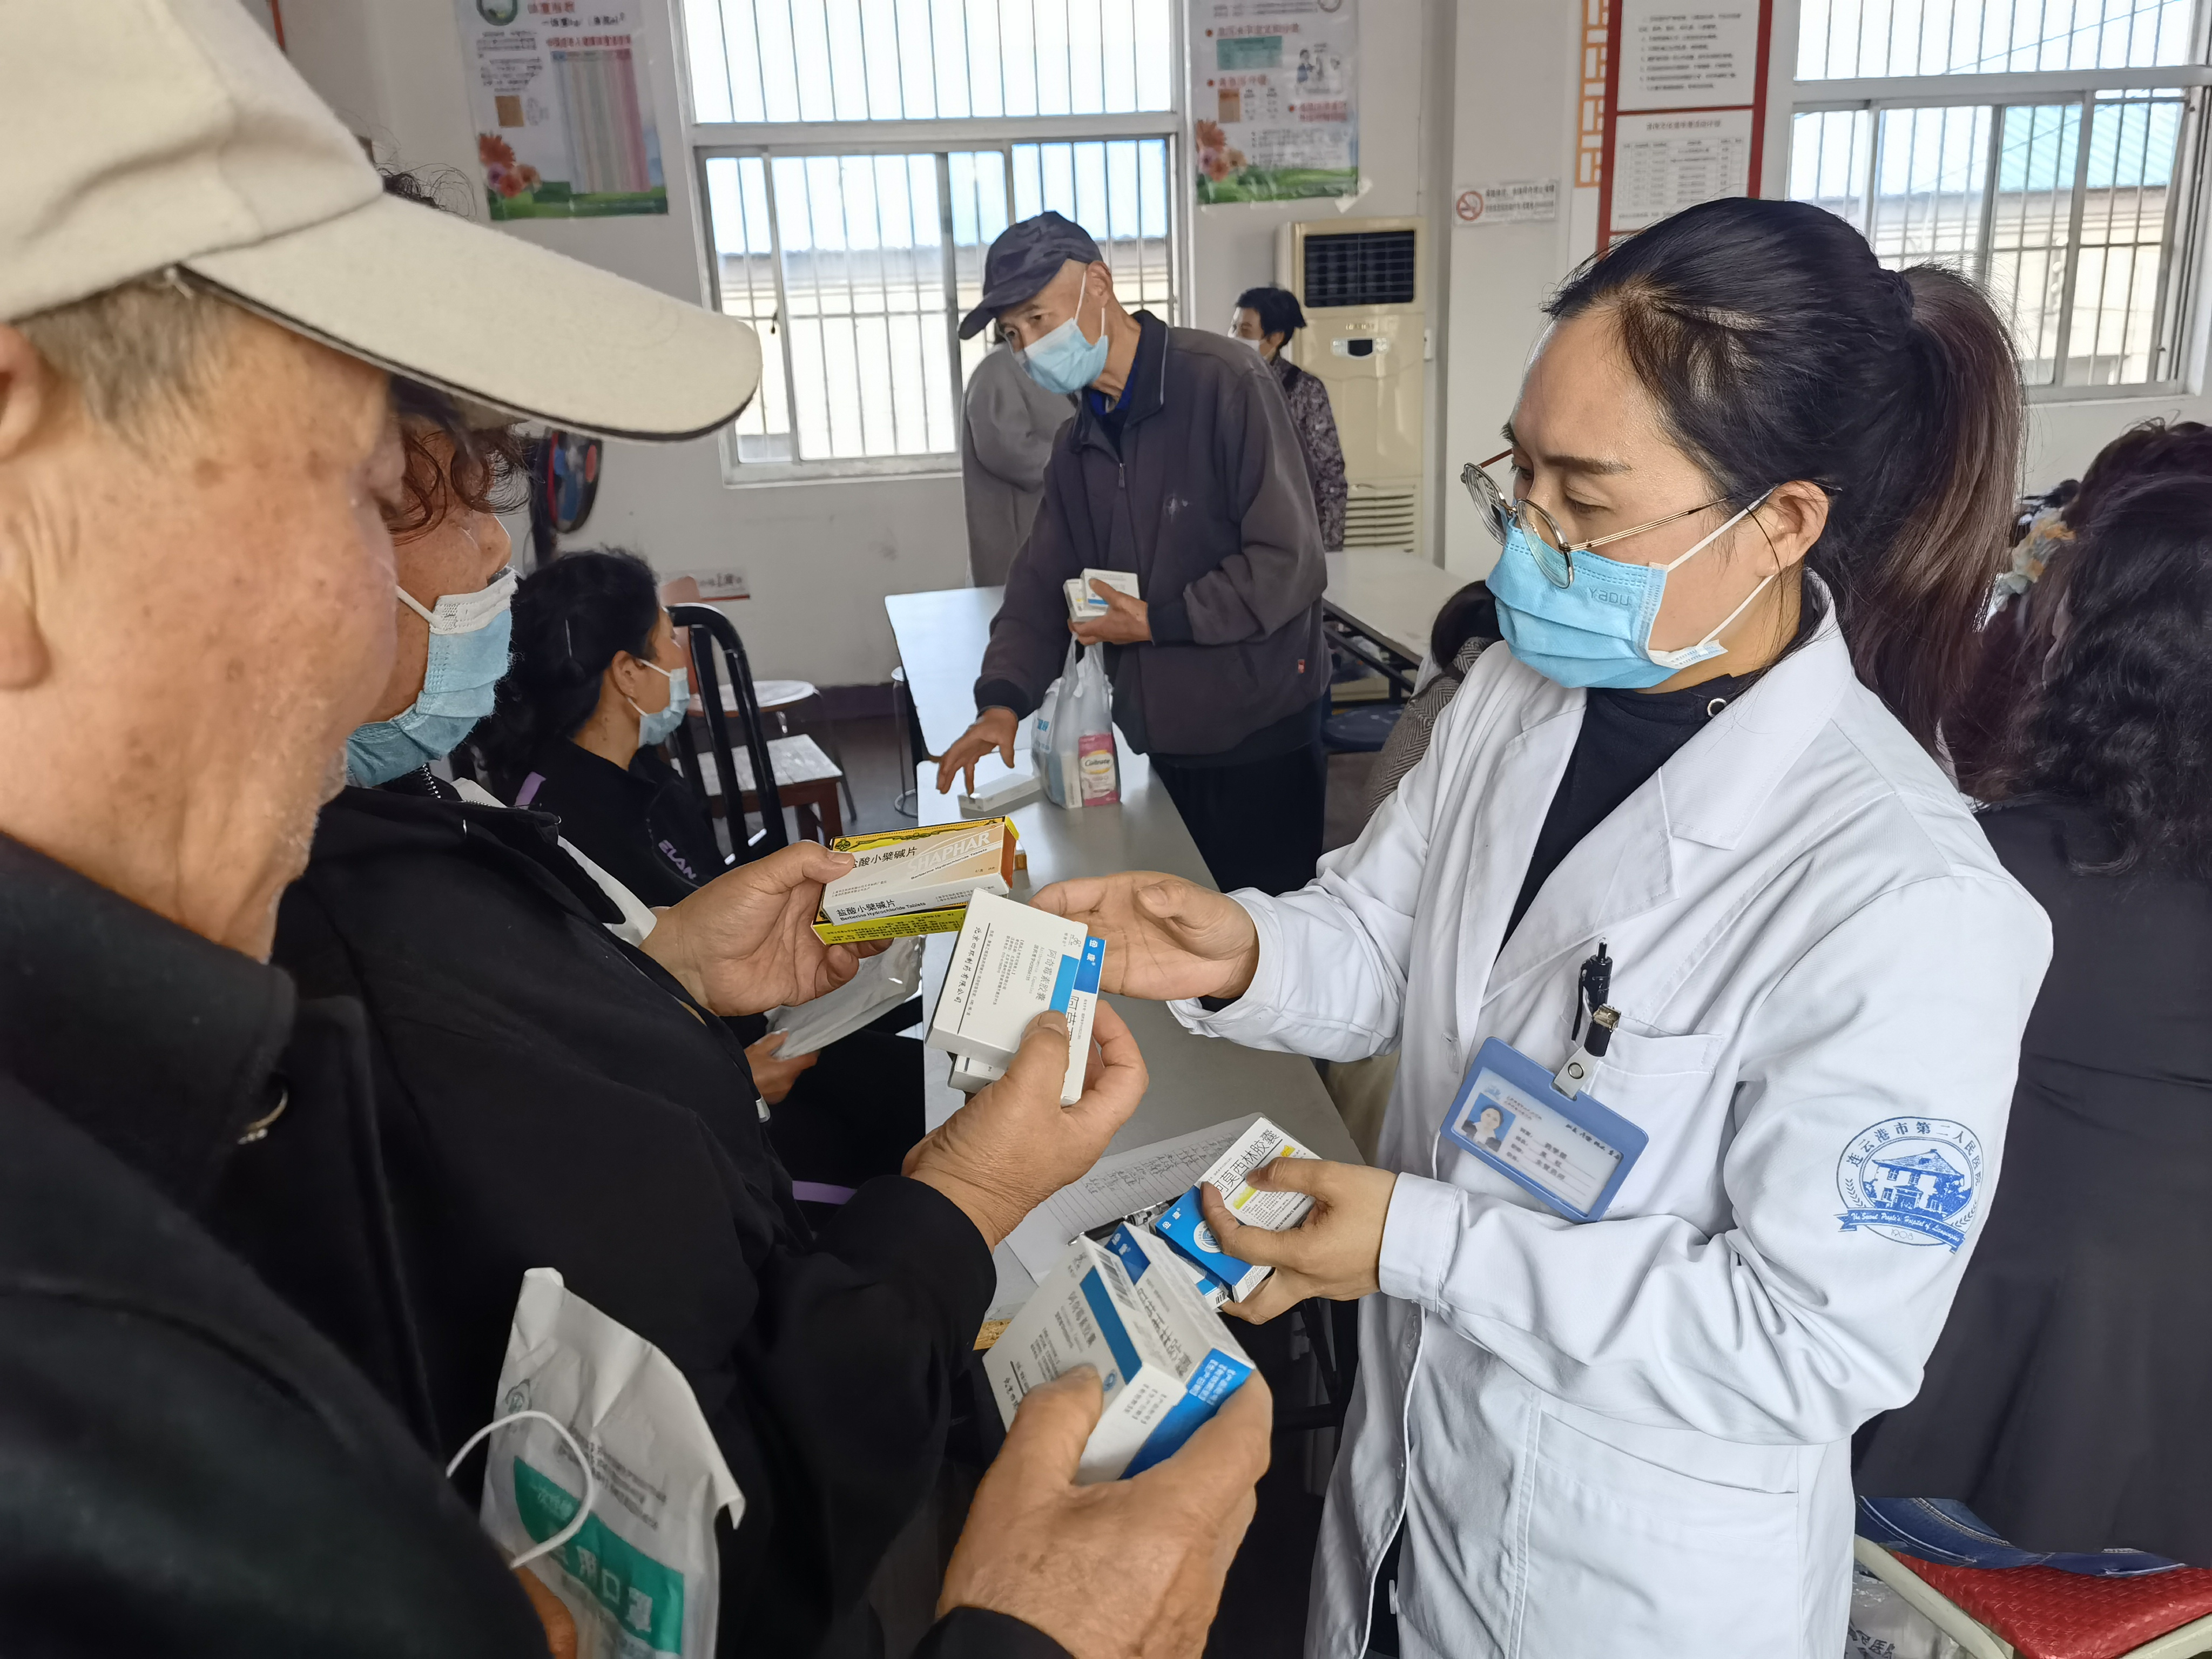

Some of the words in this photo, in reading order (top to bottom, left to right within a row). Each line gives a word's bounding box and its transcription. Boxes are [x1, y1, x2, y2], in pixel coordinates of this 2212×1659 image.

[906, 832, 991, 873] SHAPHAR
[836, 899, 895, 918] 盐酸小檗碱片
[840, 912, 866, 921] Berberine
[867, 906, 906, 917] Hydrochloride
[954, 926, 982, 1003] 北京四环制药有限公司
[1035, 948, 1057, 1001] 阿奇霉素胶囊
[1846, 1121, 1982, 1187] 连云港市第二人民医院
[1851, 1212, 1861, 1220] The
[1861, 1212, 1879, 1220] Second
[1891, 1229, 1914, 1240] 1908
